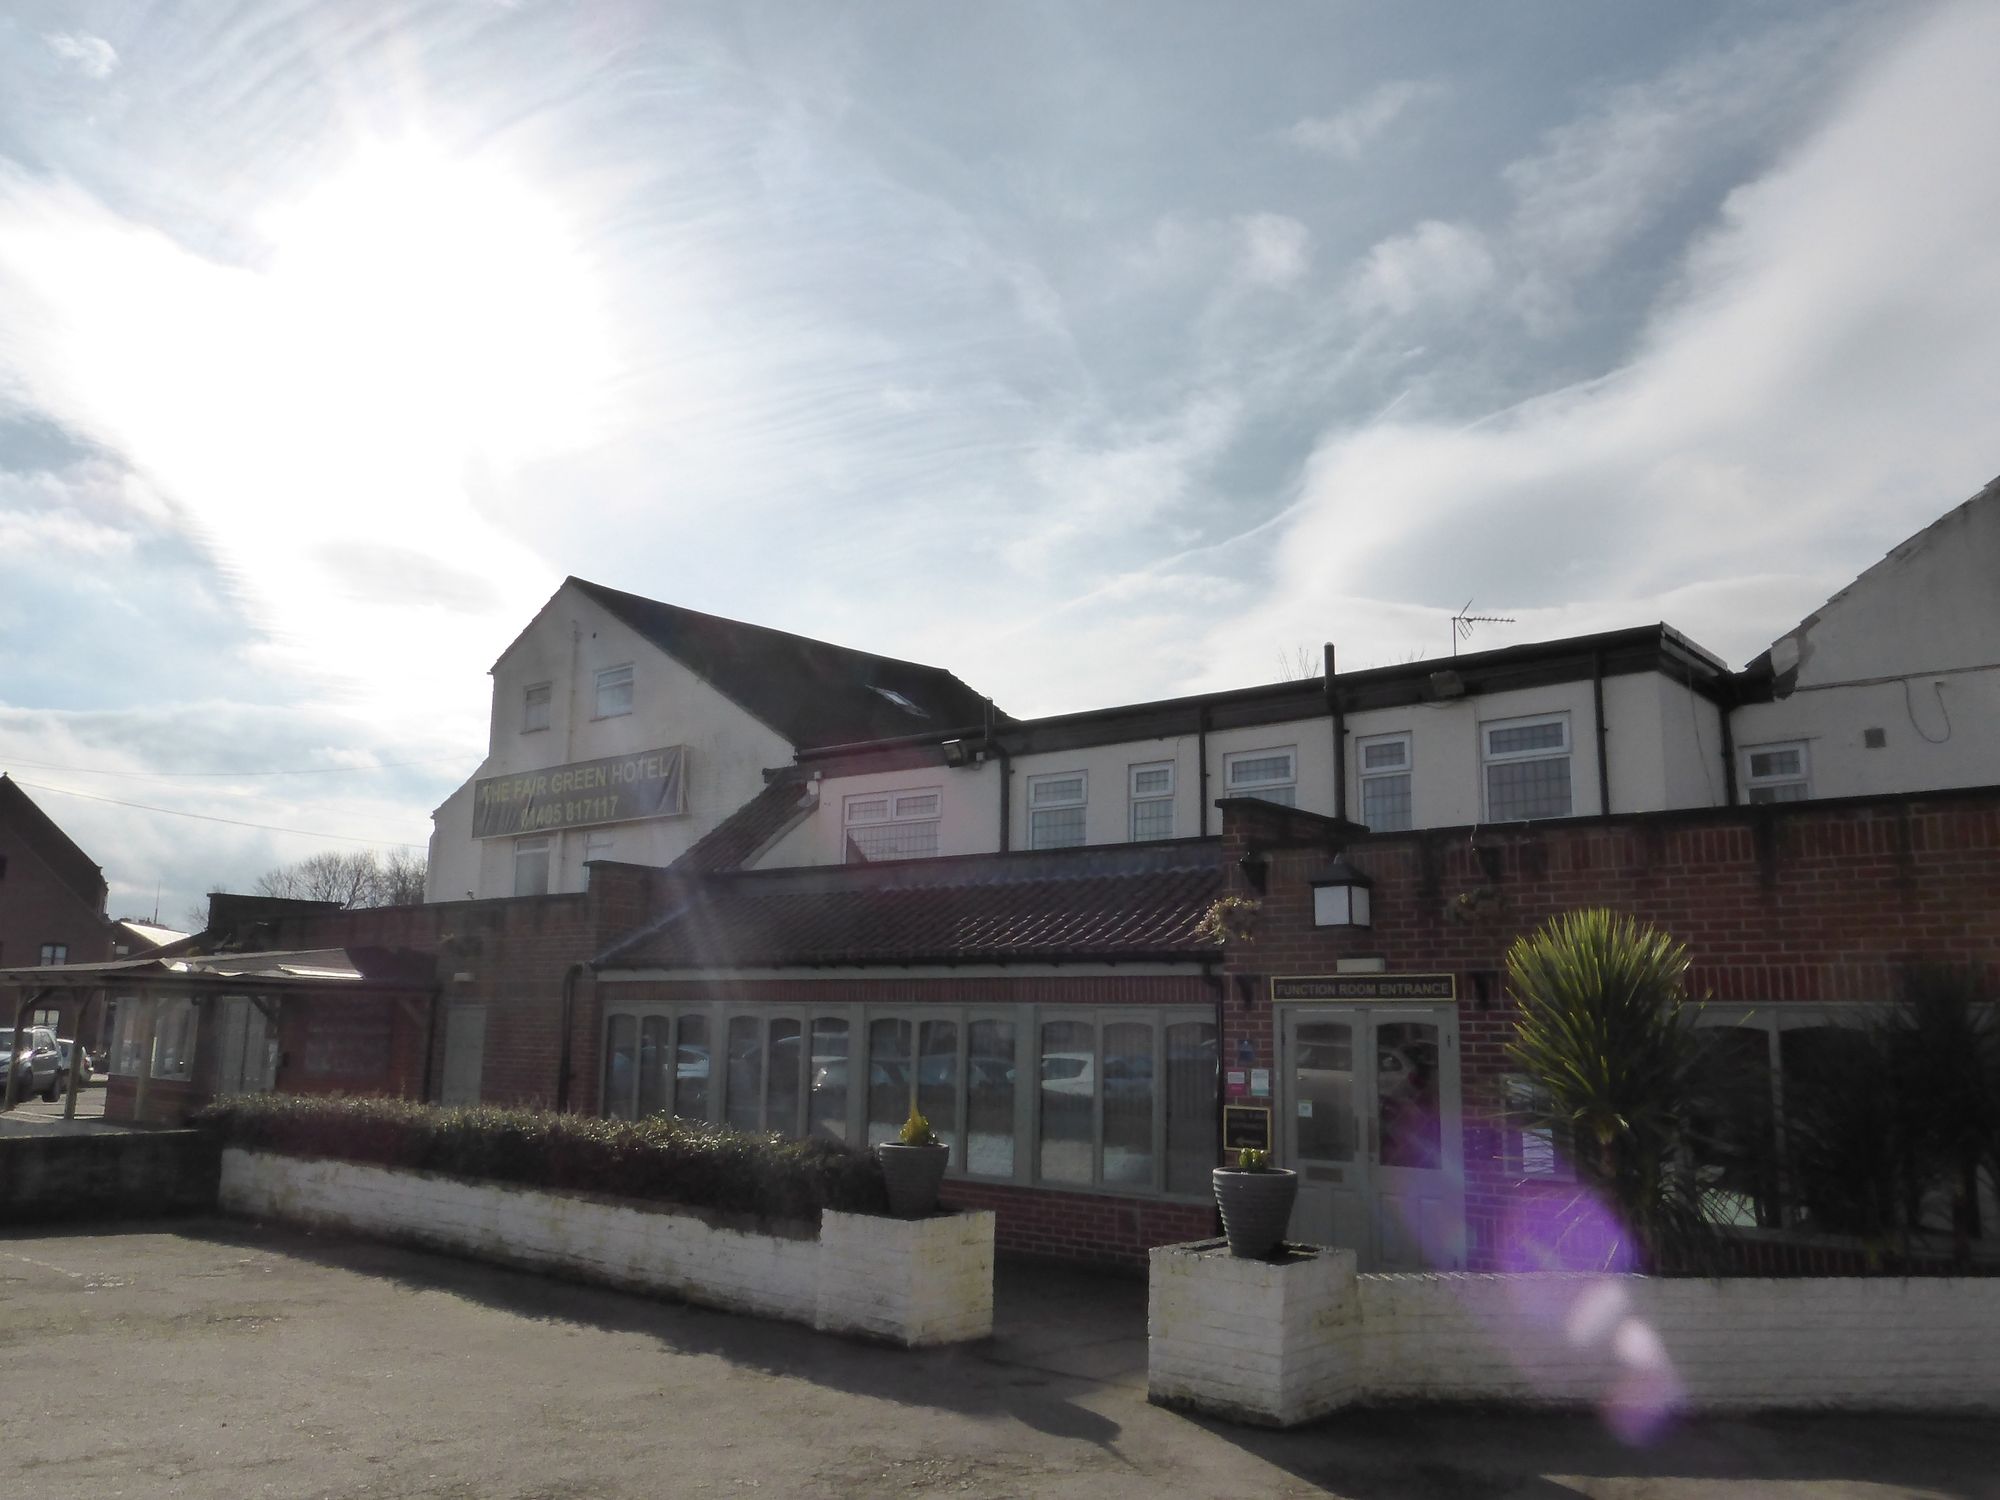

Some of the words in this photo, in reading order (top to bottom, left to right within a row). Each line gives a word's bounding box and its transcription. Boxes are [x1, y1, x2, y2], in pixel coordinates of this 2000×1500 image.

[483, 782, 510, 804] THE
[514, 776, 546, 797] FAIR
[552, 768, 606, 793] GREEN
[612, 757, 669, 784] HOTEL
[566, 797, 618, 822] 817117
[1277, 984, 1336, 996] FUNCTION
[1339, 983, 1376, 995] ROOM
[1380, 982, 1449, 995] ENTRANCE
